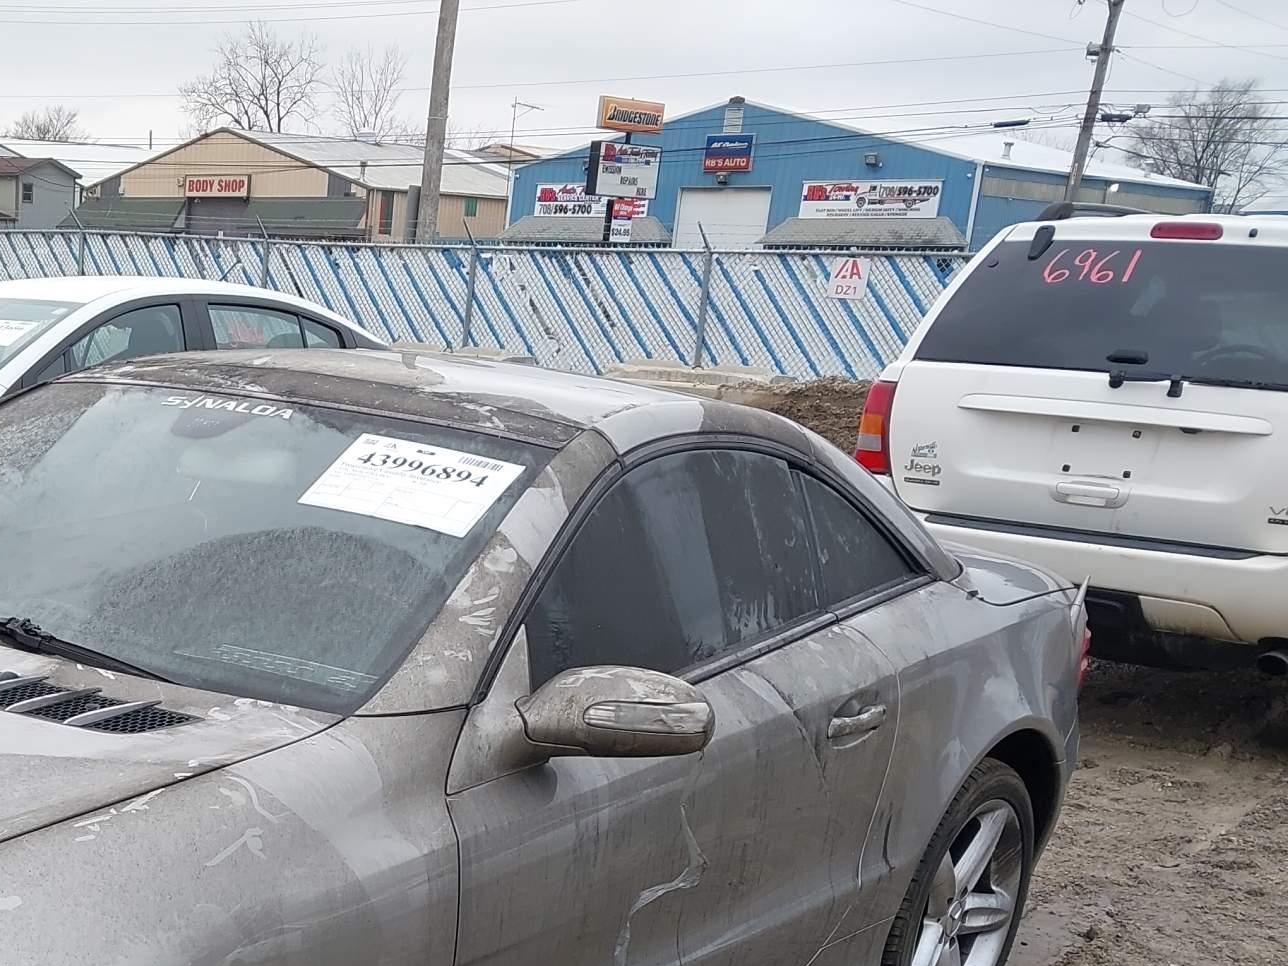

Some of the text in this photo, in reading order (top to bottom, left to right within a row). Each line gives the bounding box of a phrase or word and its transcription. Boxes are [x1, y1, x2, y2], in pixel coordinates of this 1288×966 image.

[607, 105, 661, 126] BRIDGESTONE
[724, 158, 747, 167] AUTO
[188, 179, 245, 192] BODY SHOP
[538, 204, 592, 215] 708/596-5700
[1043, 249, 1143, 283] 6961
[835, 285, 857, 295] DZ1
[358, 451, 489, 488] 43996894
[904, 459, 942, 477] Jeep
